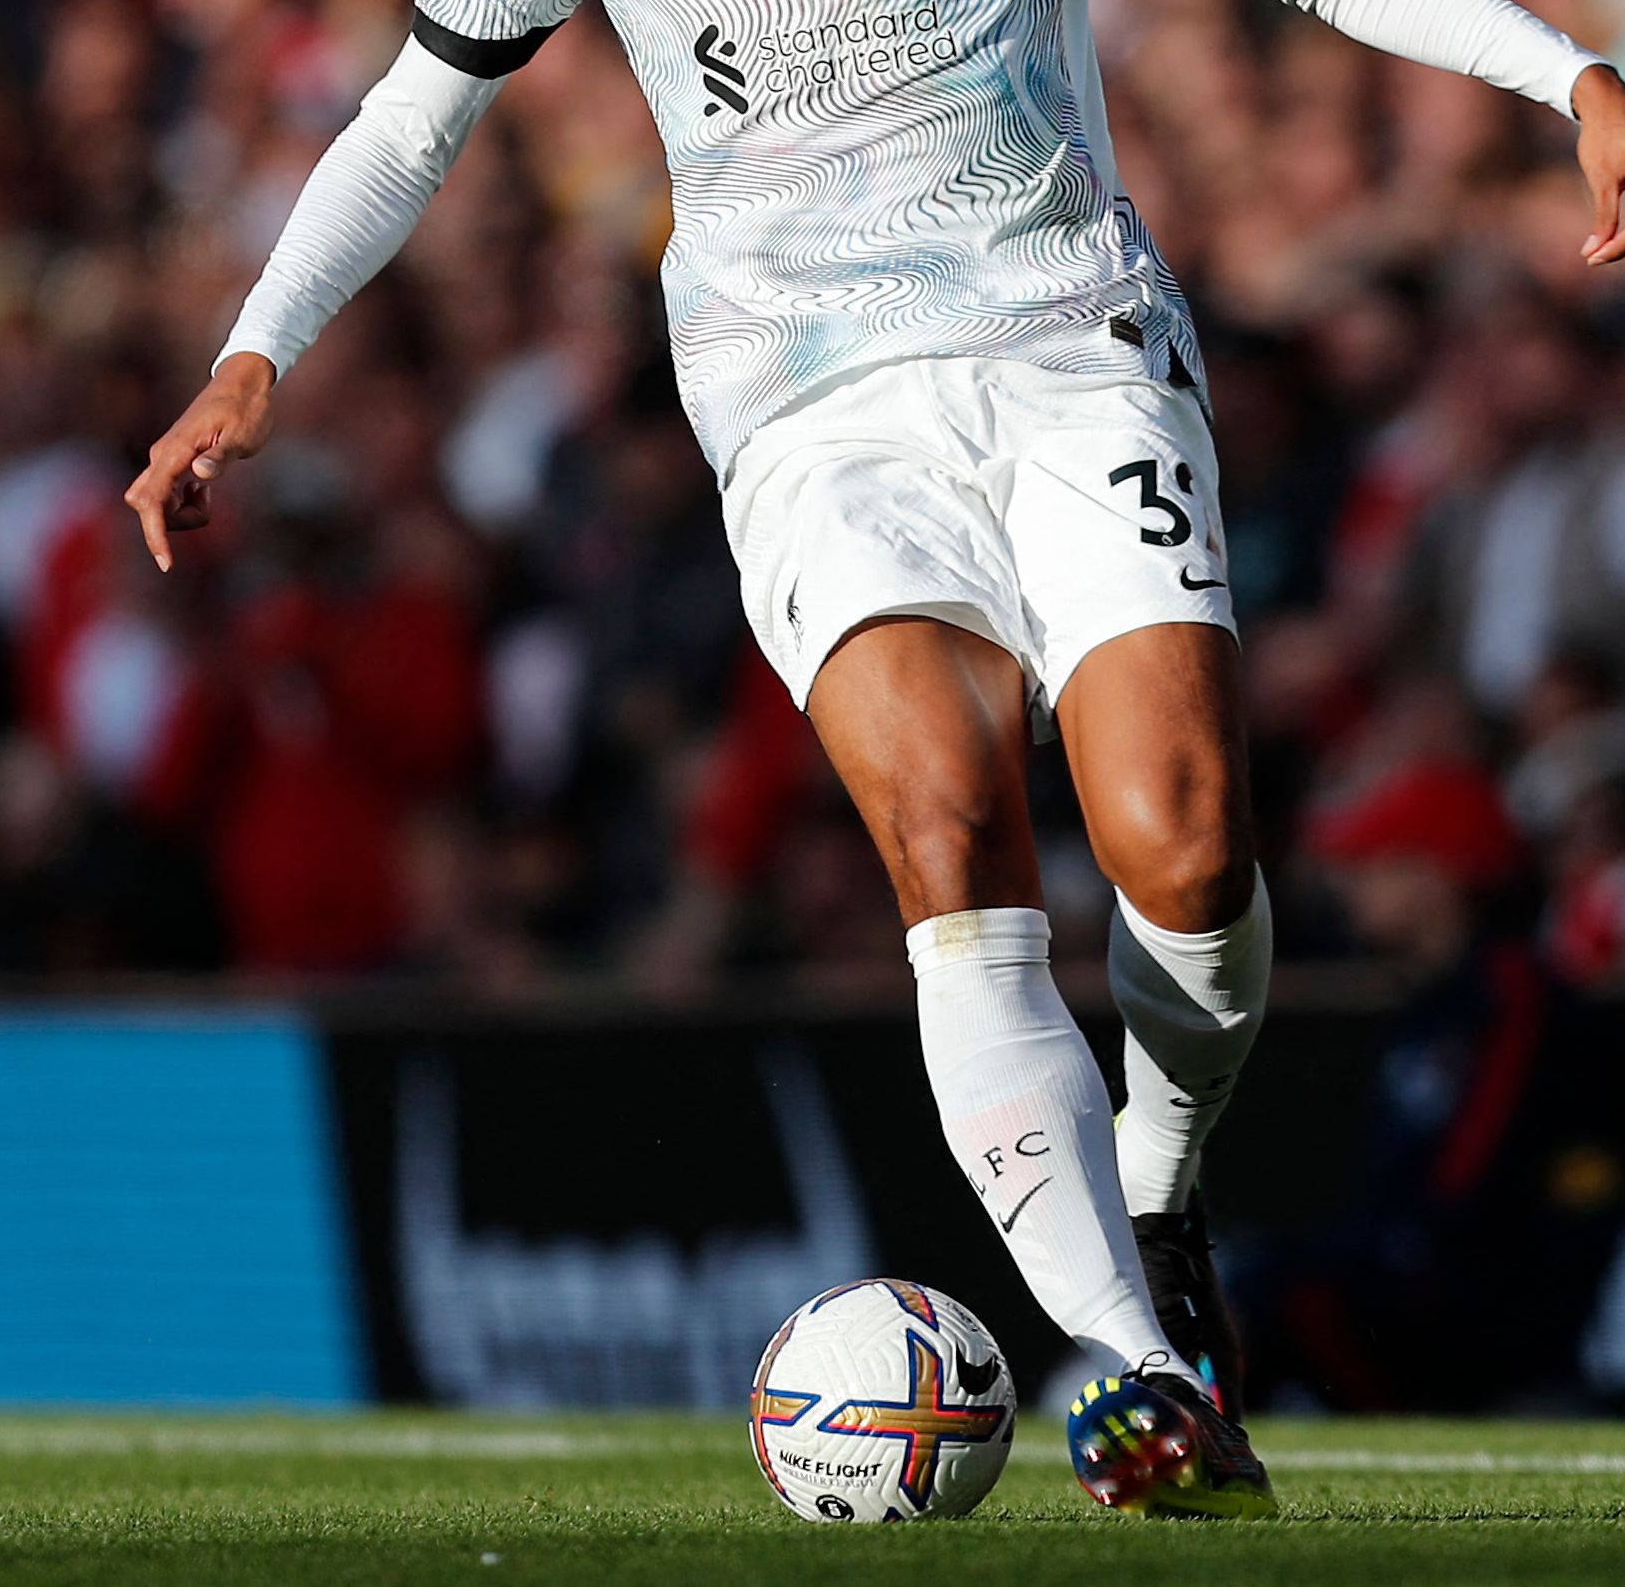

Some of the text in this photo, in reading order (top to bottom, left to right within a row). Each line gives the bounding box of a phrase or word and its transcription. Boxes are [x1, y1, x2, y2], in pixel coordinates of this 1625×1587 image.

[758, 0, 939, 61] standard
[765, 29, 959, 93] chartered
[779, 1449, 883, 1478] NIKE FLIGHT
